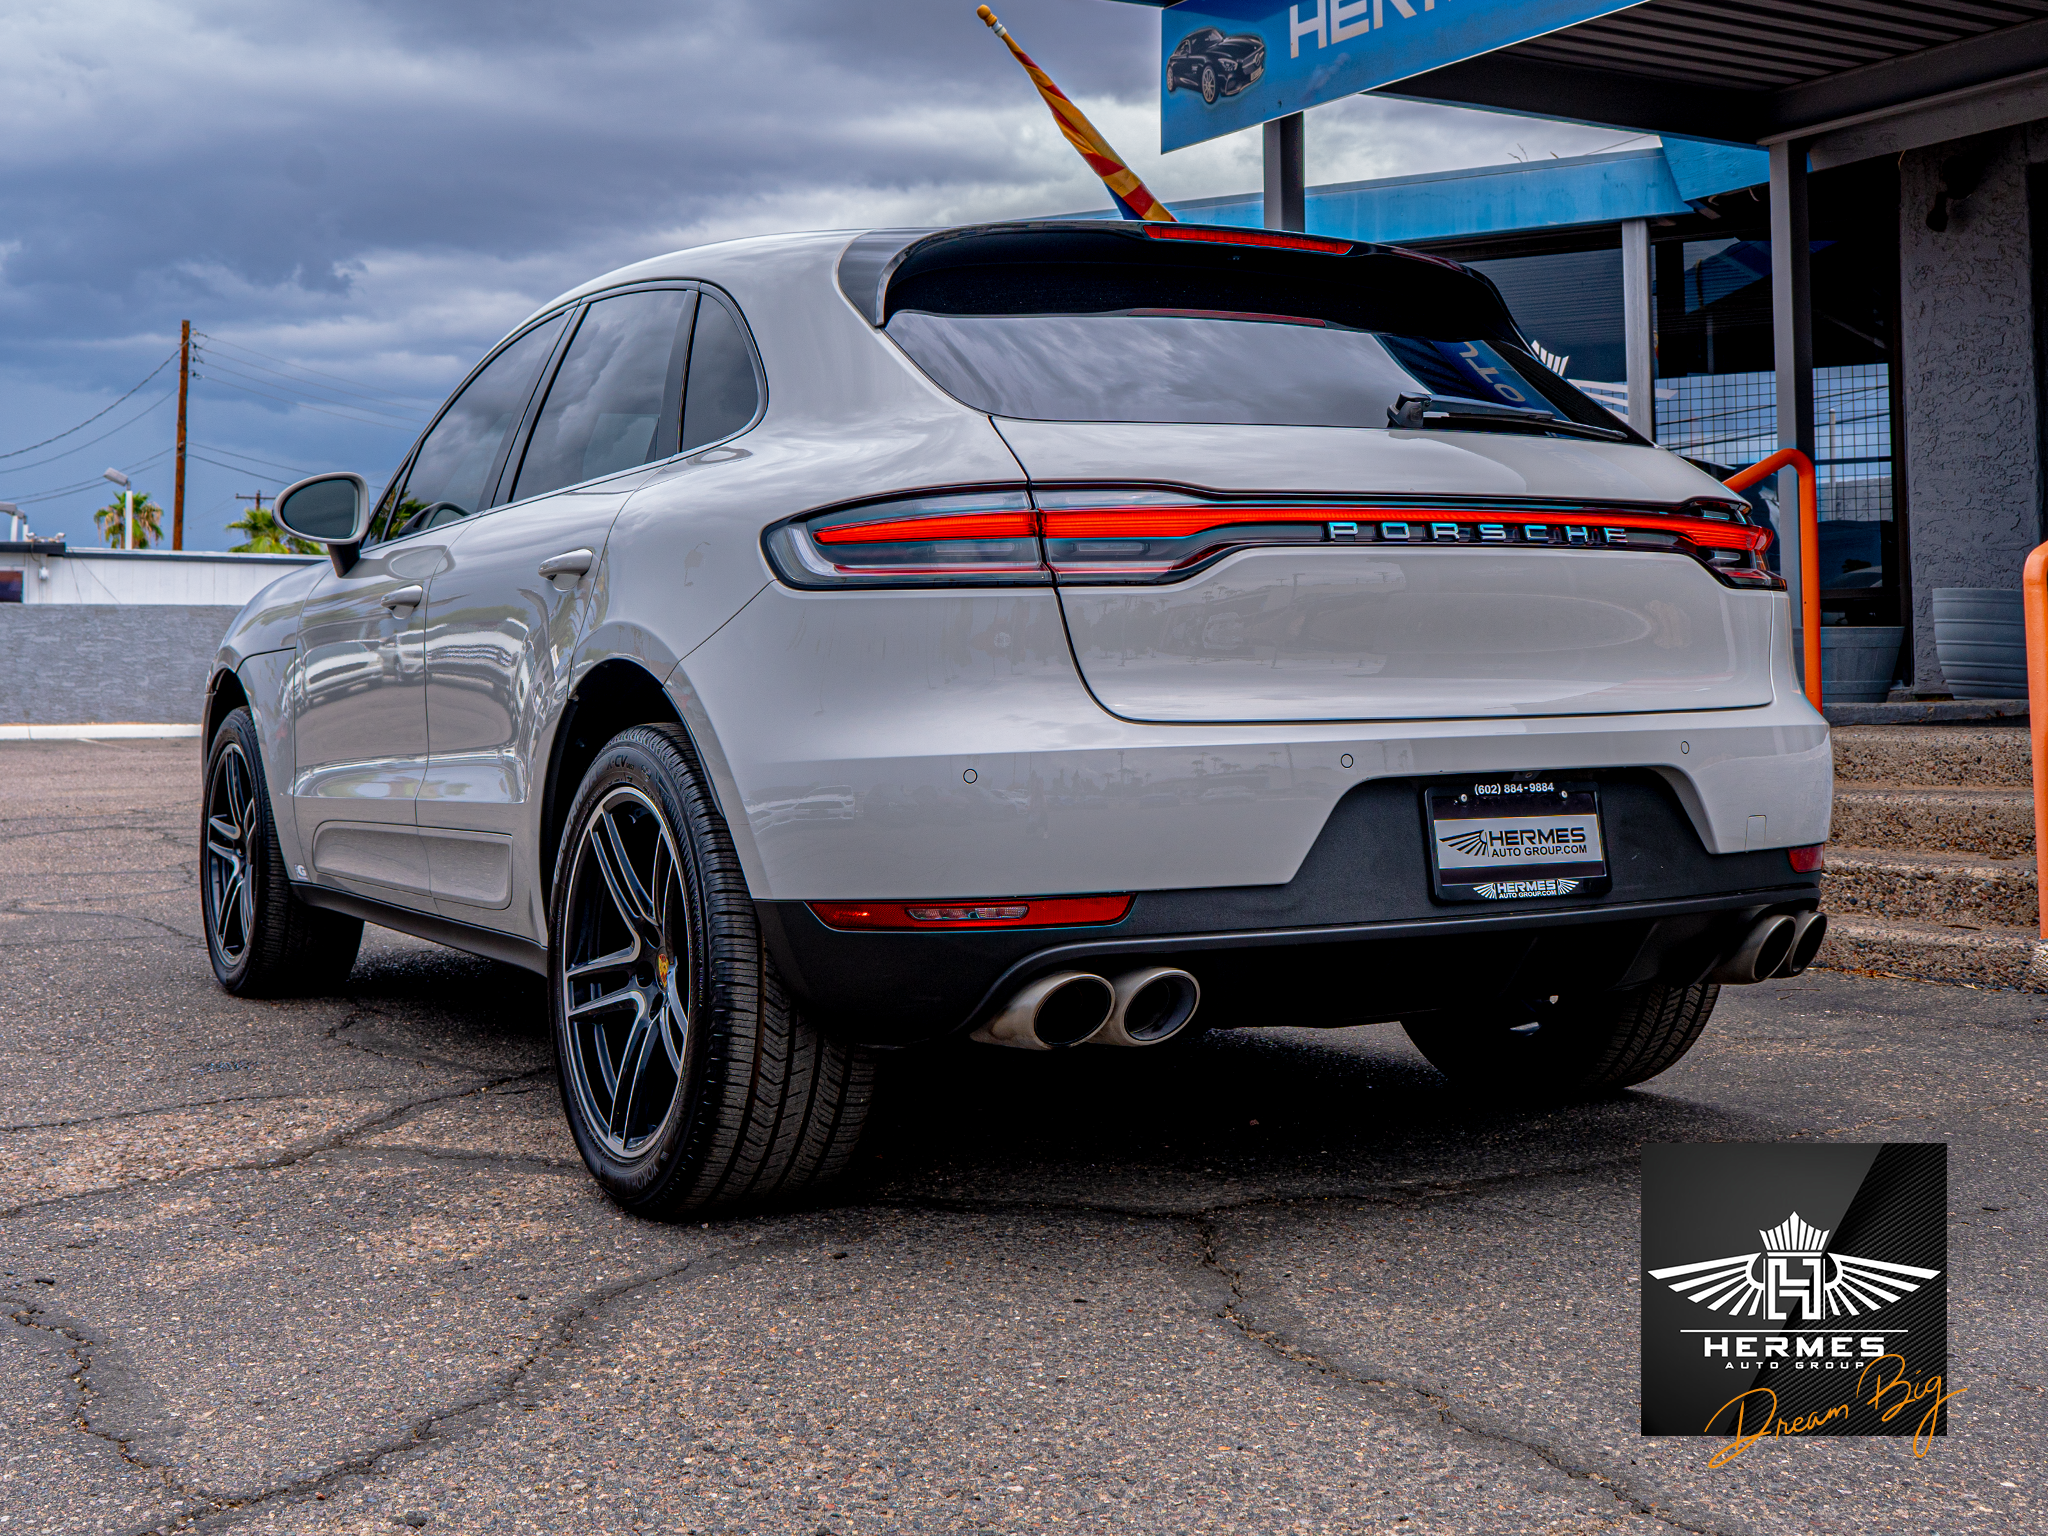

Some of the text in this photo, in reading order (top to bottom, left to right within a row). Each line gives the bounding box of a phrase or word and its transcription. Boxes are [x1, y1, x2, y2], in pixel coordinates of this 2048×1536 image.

[1290, 0, 1456, 59] HER
[1328, 521, 1629, 544] PORSCHE
[1474, 782, 1555, 796] (602) 884-9884
[1488, 826, 1587, 847] HERMES
[1491, 844, 1588, 858] AUTO GROUP.COM
[1497, 880, 1556, 893] HERMES
[1498, 889, 1557, 899] AUTO GROUP.COM
